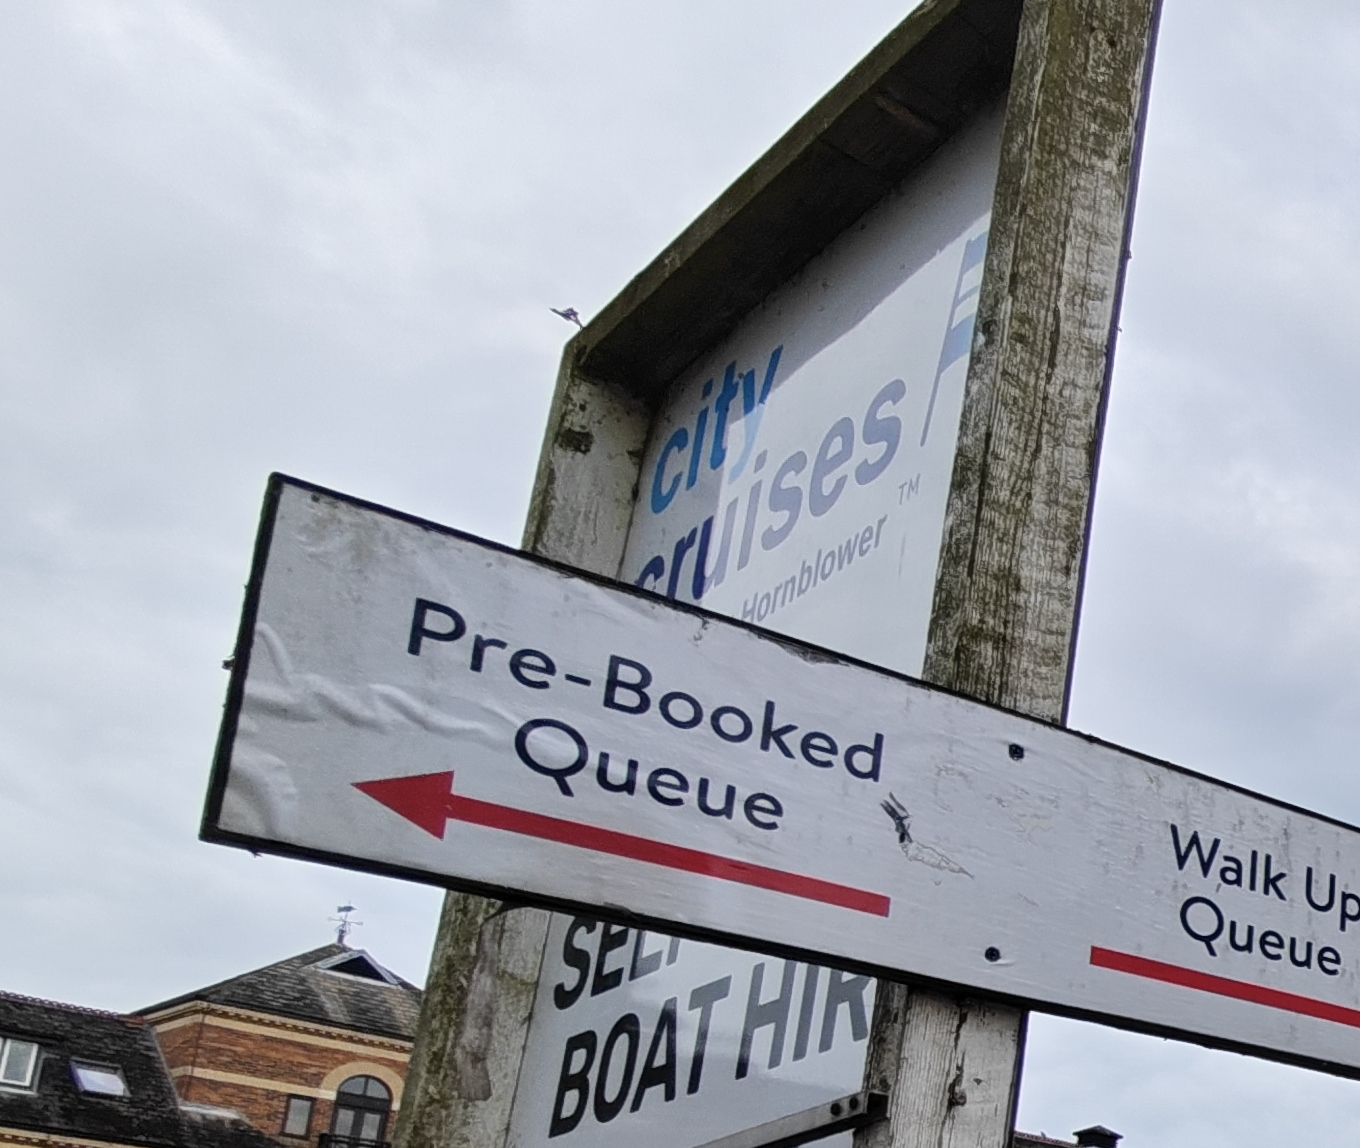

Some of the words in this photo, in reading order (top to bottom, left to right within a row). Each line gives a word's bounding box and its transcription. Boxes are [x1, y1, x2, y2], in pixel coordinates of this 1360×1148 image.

[650, 345, 783, 514] city
[741, 515, 888, 623] Hornblower
[407, 598, 884, 782] Pre-Booked
[514, 718, 784, 830] Queue
[1170, 824, 1286, 901] Walk
[553, 916, 681, 1010] SEL
[1180, 896, 1341, 976] Queue
[548, 975, 732, 1138] BOAT
[735, 960, 876, 1080] HIR
